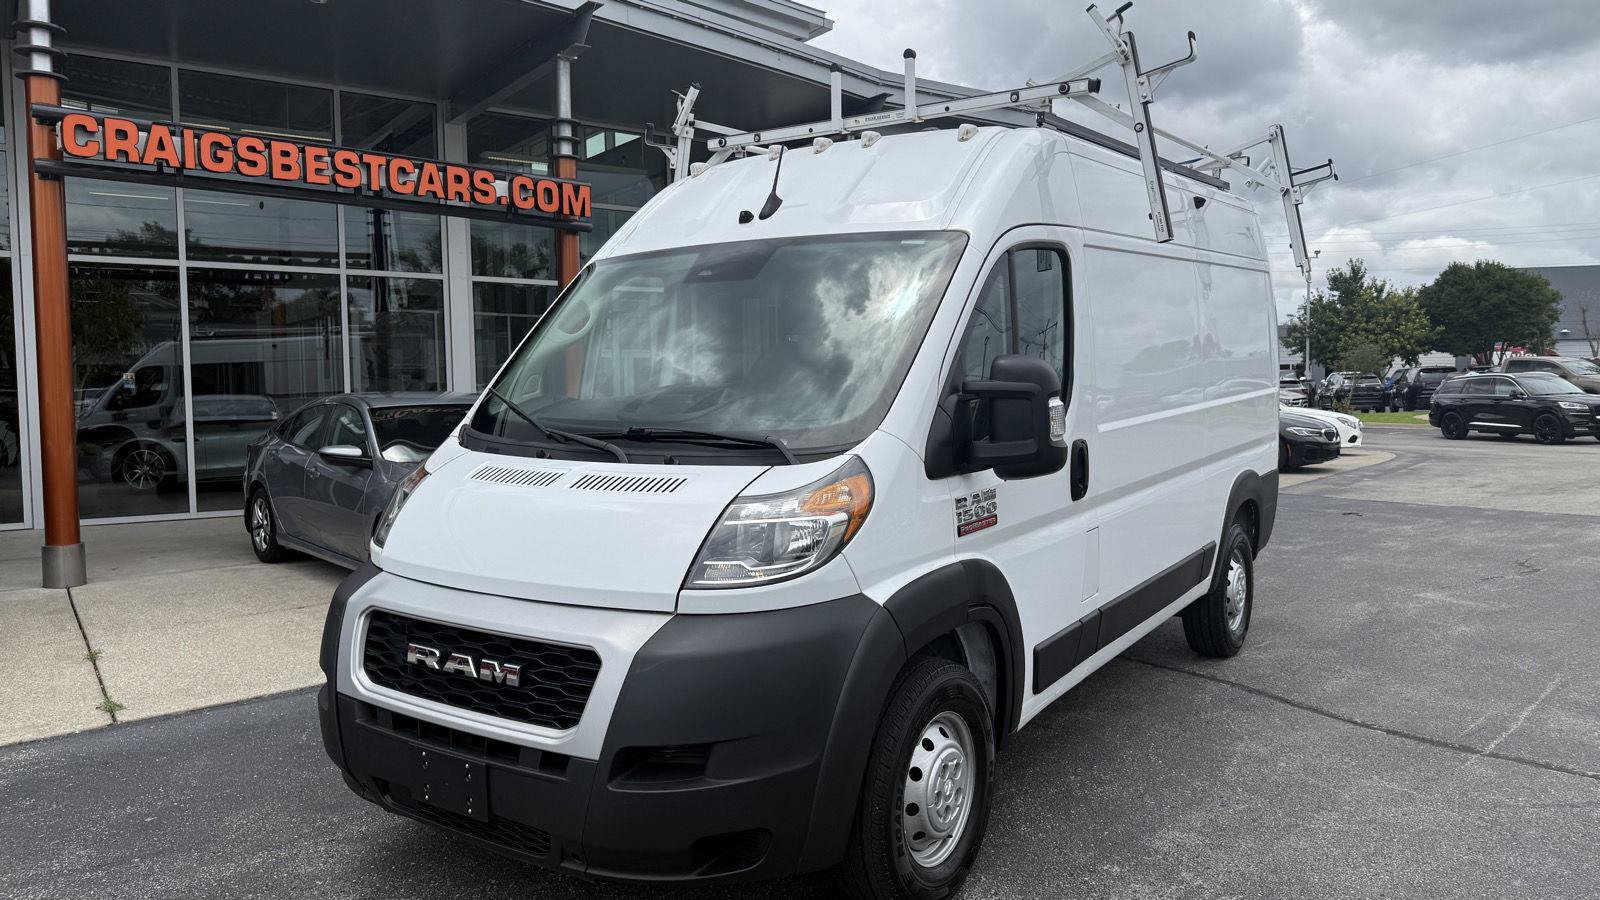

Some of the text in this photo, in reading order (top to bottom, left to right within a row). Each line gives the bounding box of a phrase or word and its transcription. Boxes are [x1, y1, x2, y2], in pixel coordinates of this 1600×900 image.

[61, 112, 592, 218] CRAIGSBESTCARS.COM
[955, 488, 997, 510] RAM
[956, 501, 997, 524] 1500
[407, 643, 521, 687] RAM
